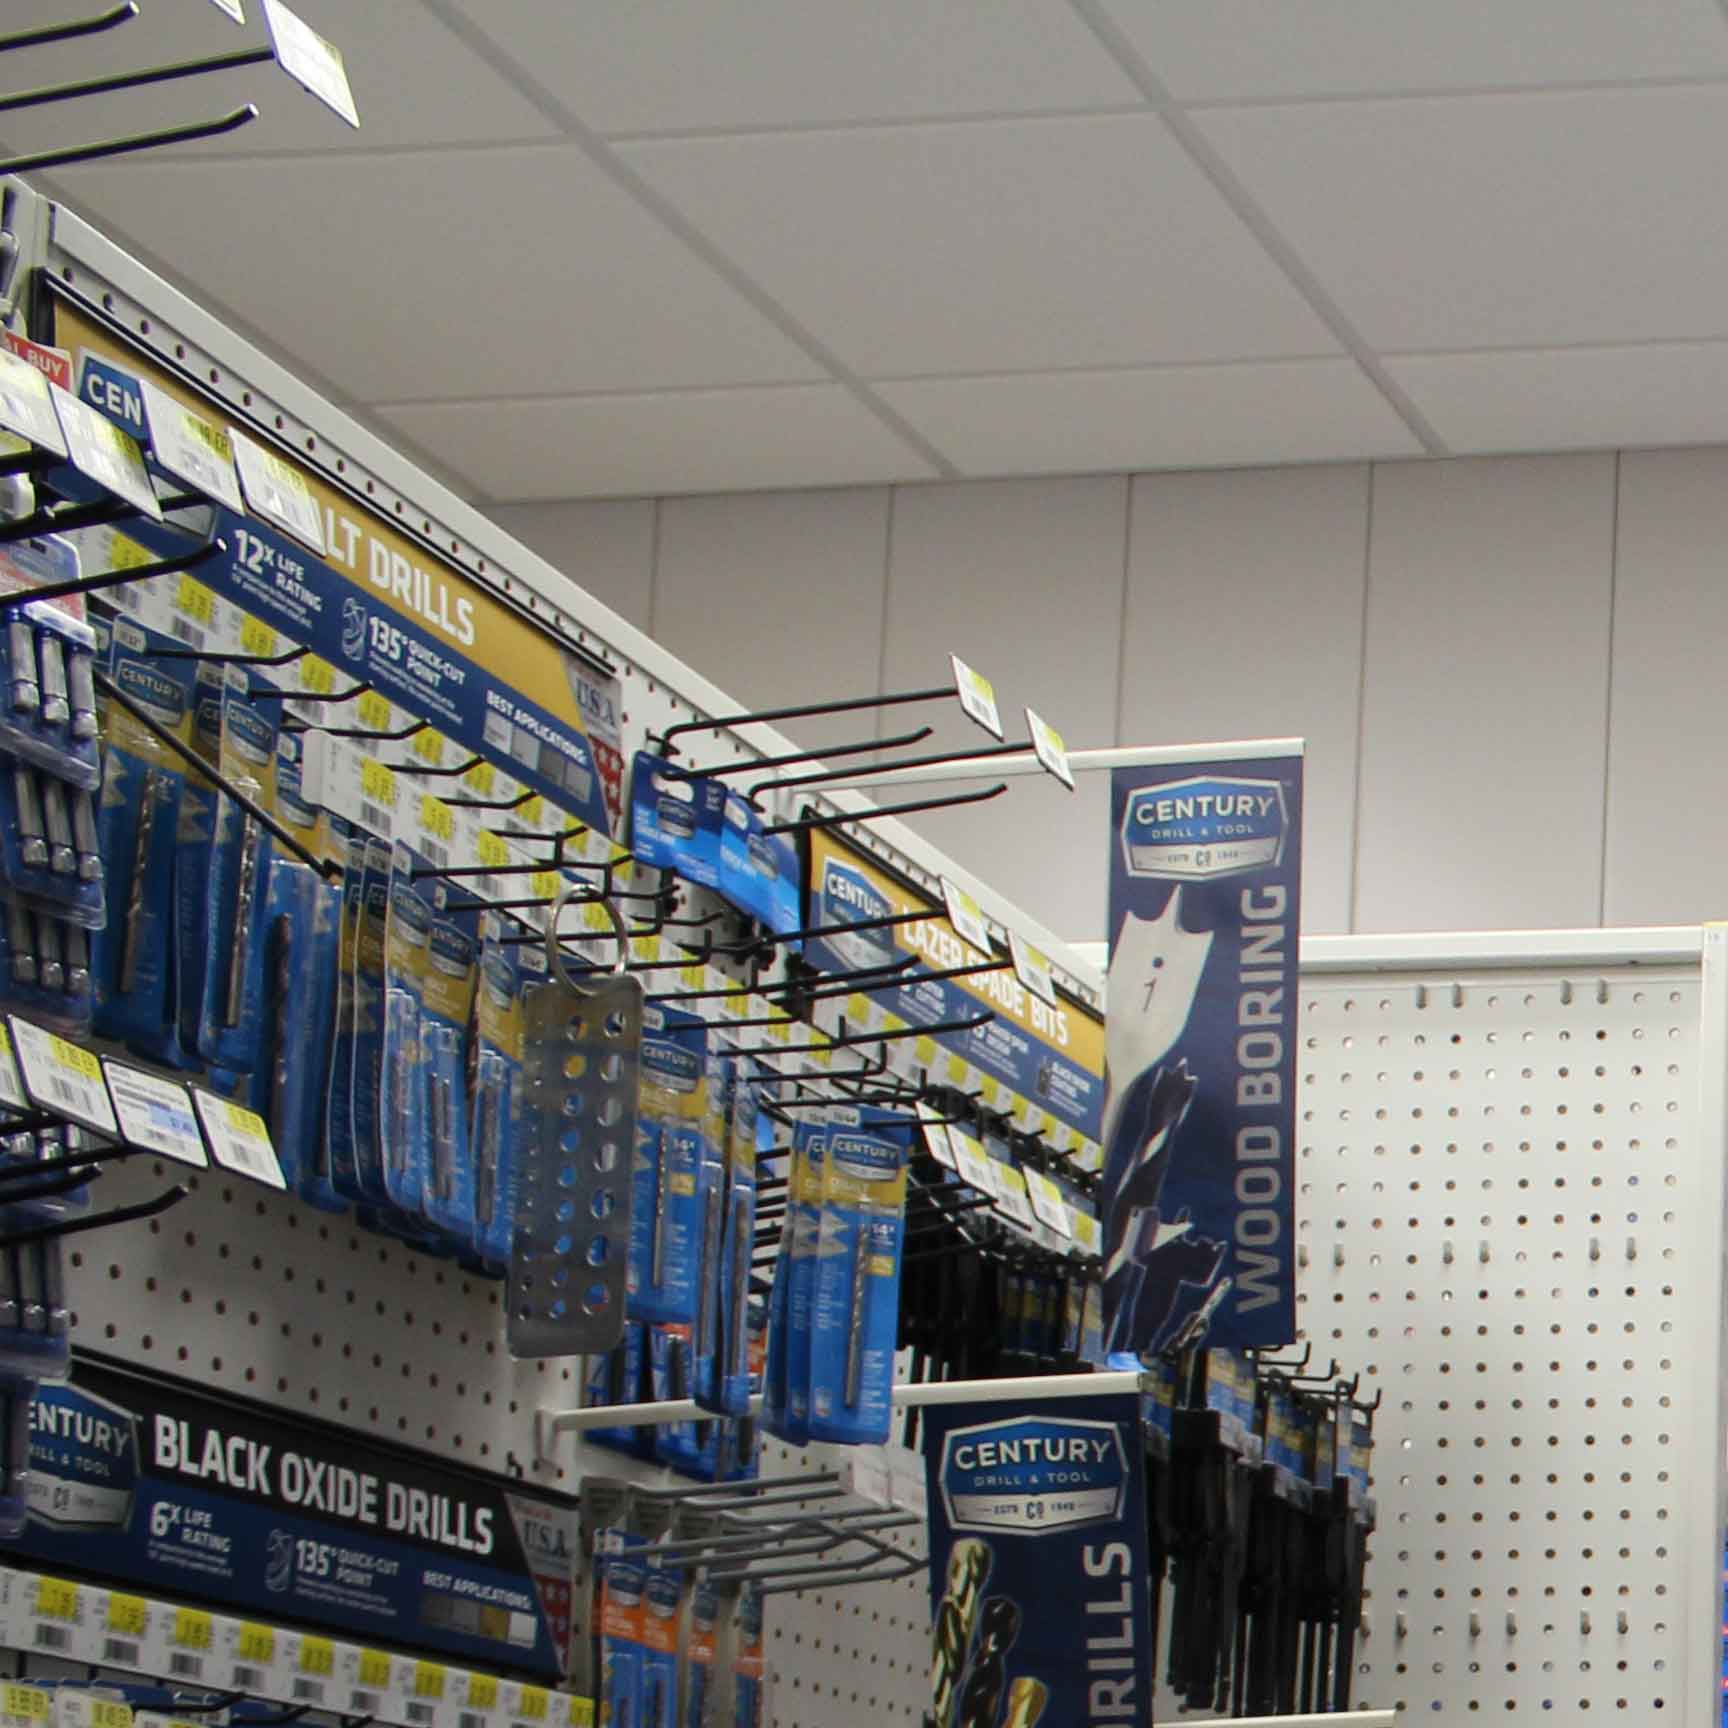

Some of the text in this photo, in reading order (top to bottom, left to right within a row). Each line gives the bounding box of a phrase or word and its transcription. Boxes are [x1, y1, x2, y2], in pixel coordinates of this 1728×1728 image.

[368, 536, 476, 647] DRILLS
[1135, 794, 1274, 826] CENTURY
[1151, 828, 1194, 840] DRILL
[1216, 823, 1254, 835] TOOL
[1030, 995, 1069, 1046] BITS
[1235, 884, 1288, 1313] WOOD BORING
[835, 1135, 898, 1162] CENTURY
[28, 1400, 130, 1457] ENTURY
[954, 1438, 1113, 1471] CENTURY
[154, 1413, 494, 1556] BLACK OXIDE DRILLS
[974, 1474, 1021, 1488] DRILL
[1047, 1471, 1091, 1484] TOOL
[184, 1507, 213, 1529] LIFE
[181, 1528, 233, 1553] RATING
[336, 1567, 374, 1588] POINT
[423, 1570, 453, 1589] BEST
